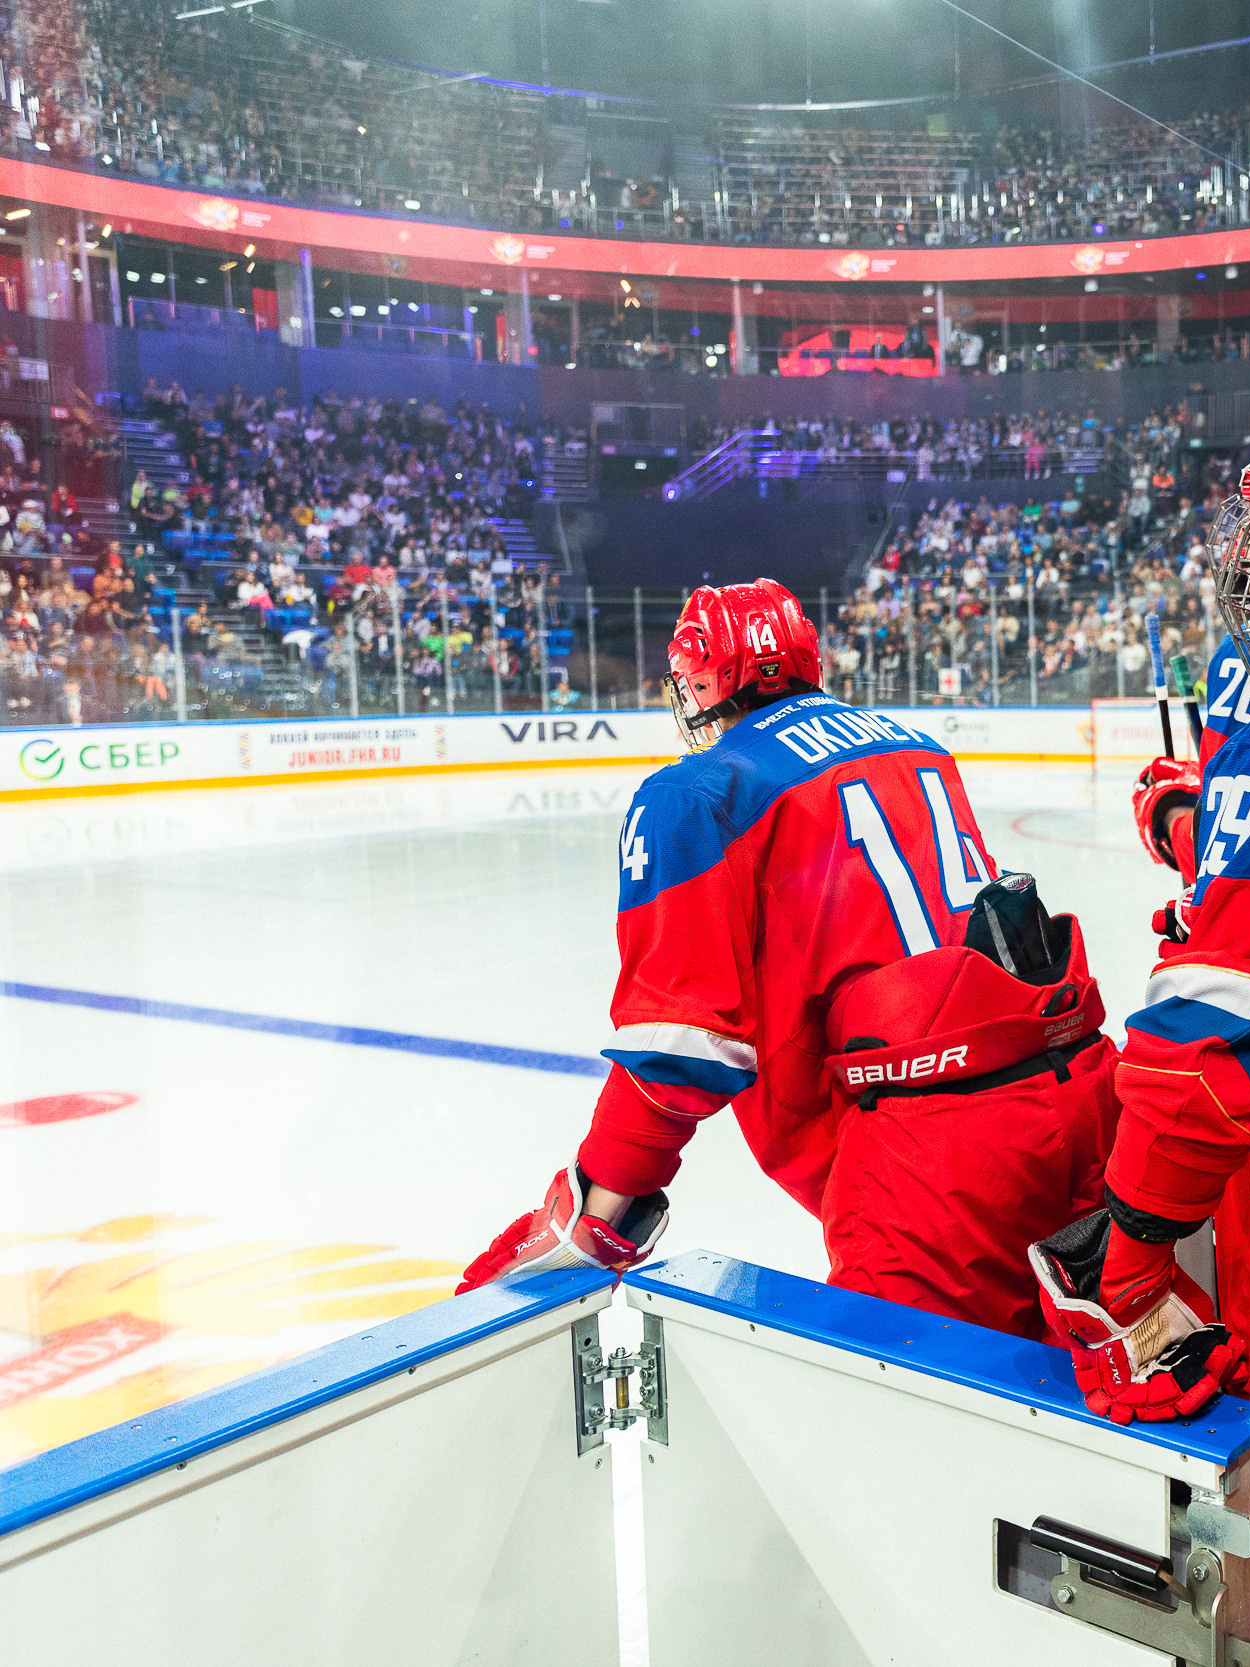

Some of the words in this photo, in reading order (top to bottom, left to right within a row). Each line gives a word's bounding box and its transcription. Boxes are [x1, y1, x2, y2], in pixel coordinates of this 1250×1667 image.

[749, 623, 777, 654] 14
[501, 720, 617, 742] VIRA
[753, 704, 801, 730] ВМЕСТЕ,
[79, 741, 180, 770] СБЕР
[847, 1045, 969, 1085] BAUER
[514, 1229, 550, 1257] TACKS
[592, 1227, 630, 1253] CCM
